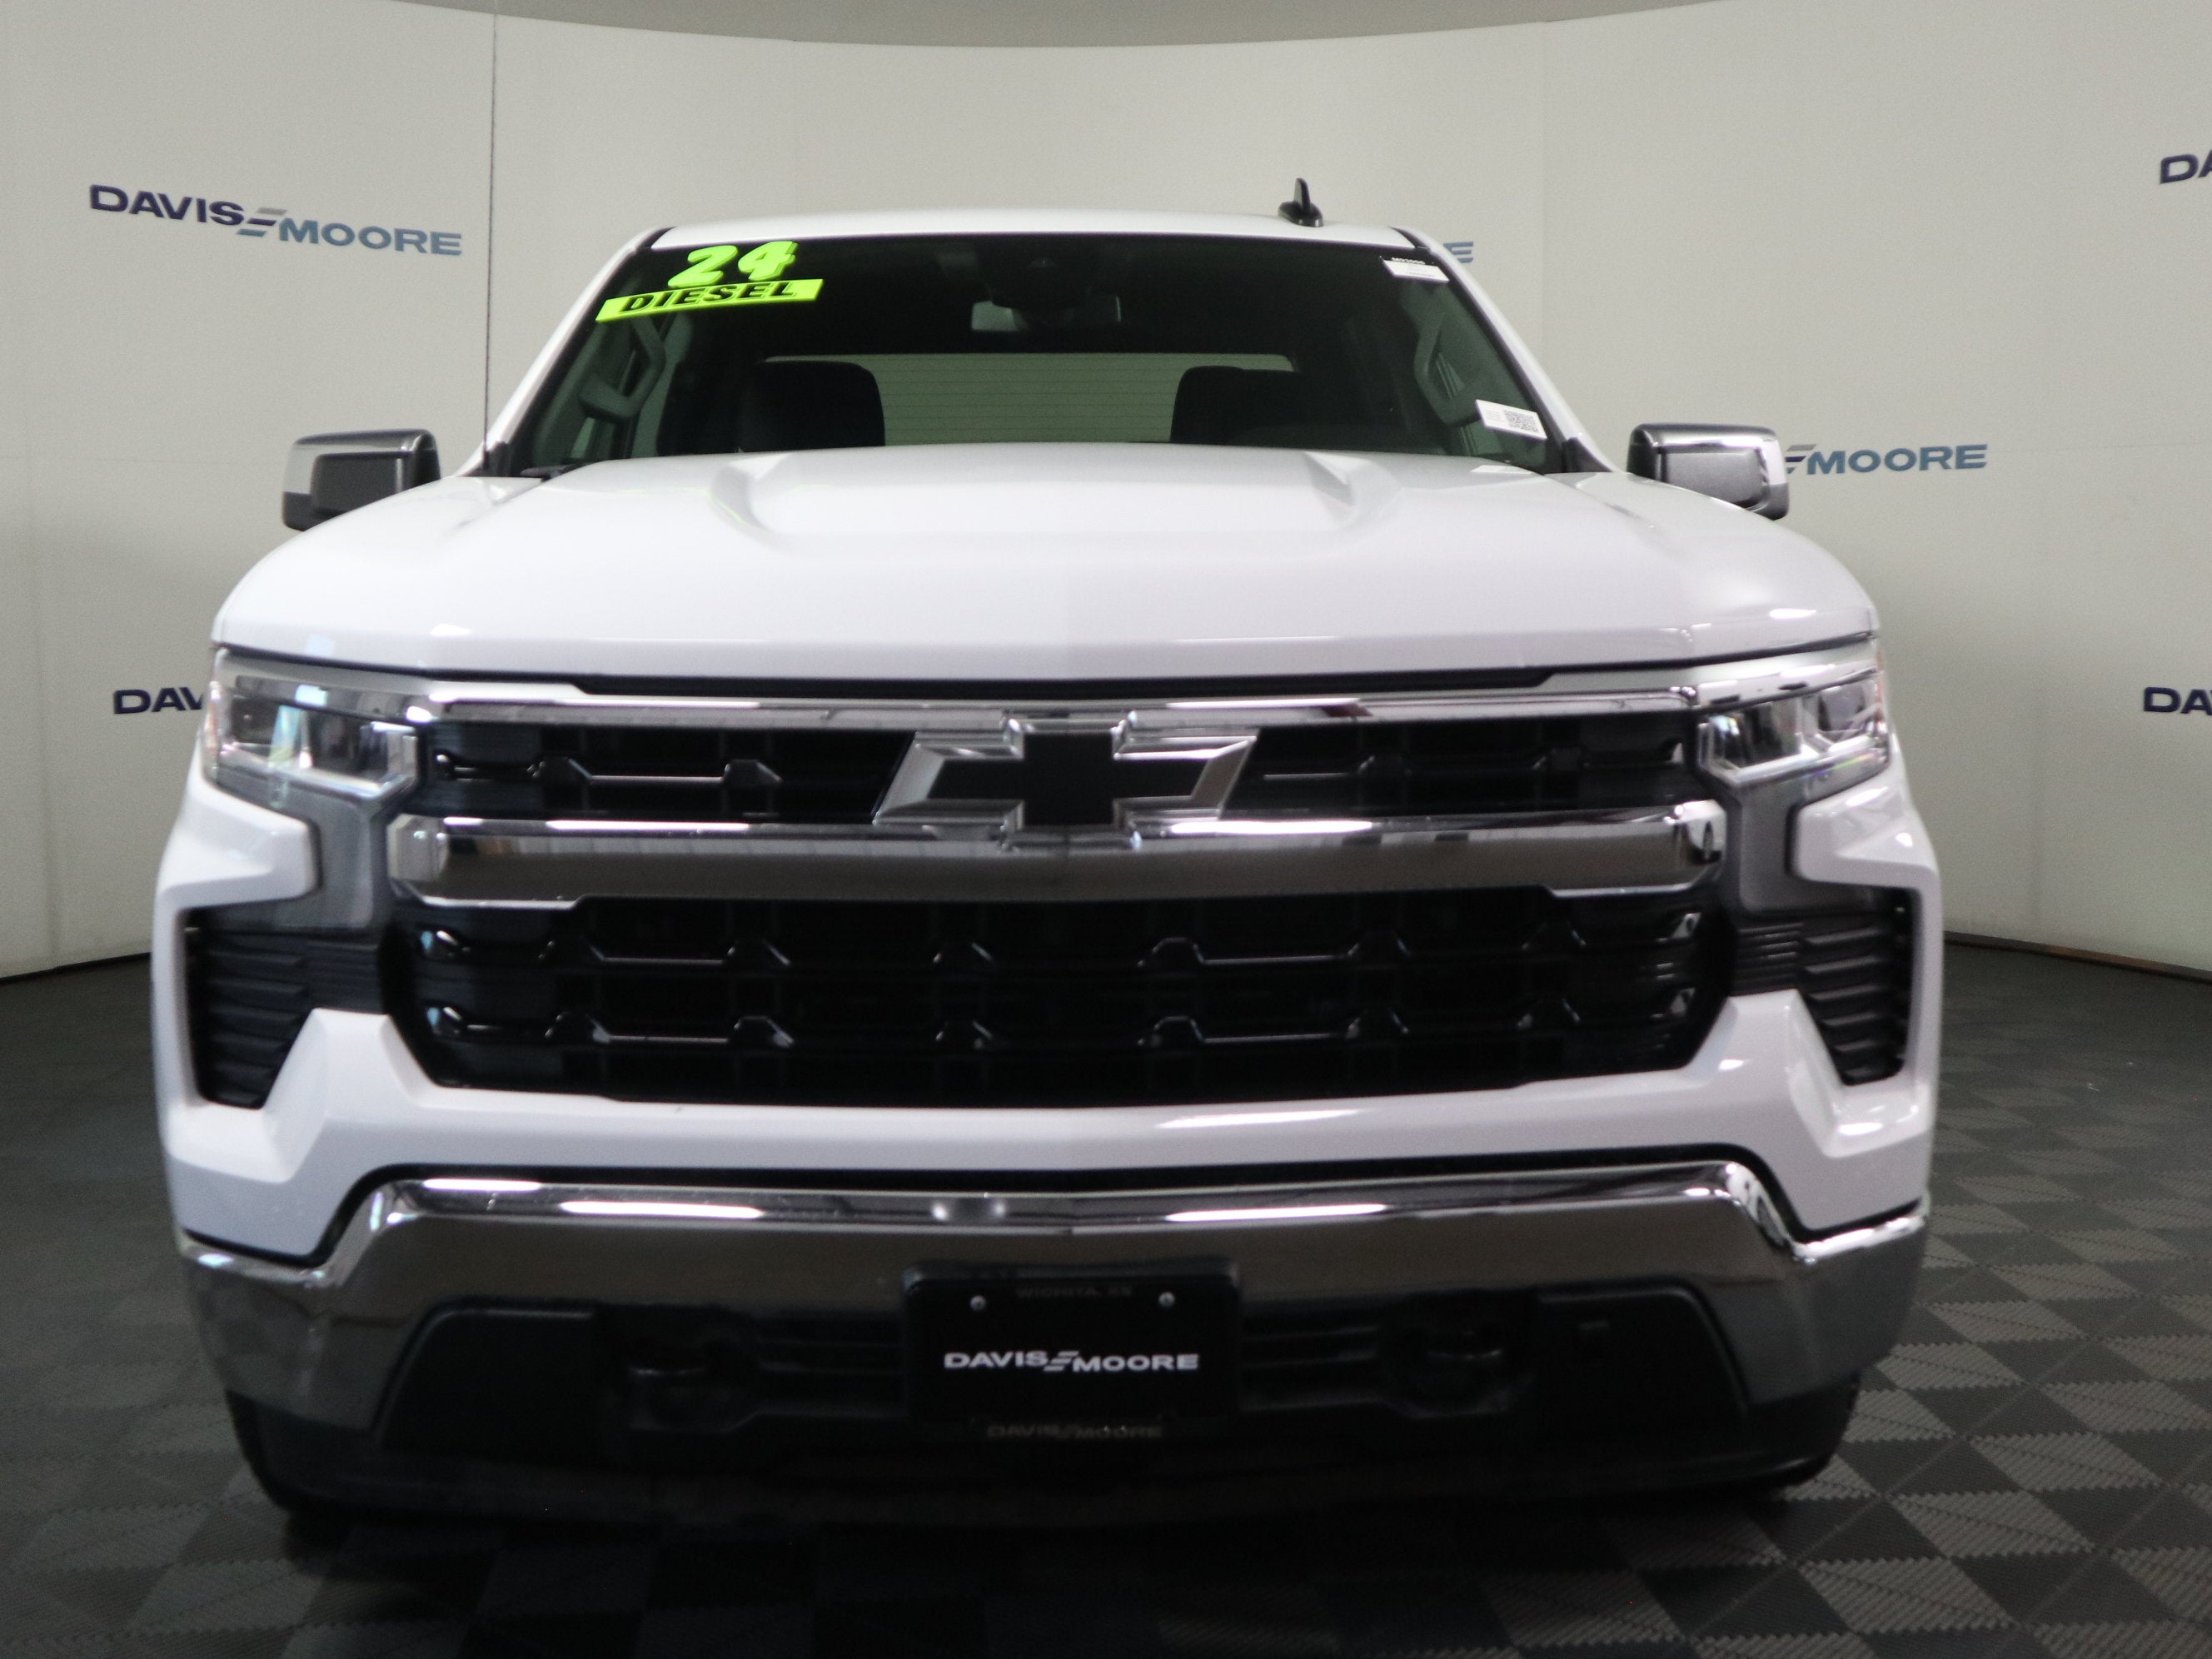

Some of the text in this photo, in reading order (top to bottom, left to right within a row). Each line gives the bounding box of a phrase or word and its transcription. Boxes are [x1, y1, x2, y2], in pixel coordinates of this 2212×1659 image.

[89, 184, 462, 256] DAVIS MOORE
[667, 241, 798, 286] 24
[620, 281, 795, 313] DIESEL
[1806, 444, 1987, 475] MOORE
[944, 1351, 1199, 1373] DAVIS MOORE
